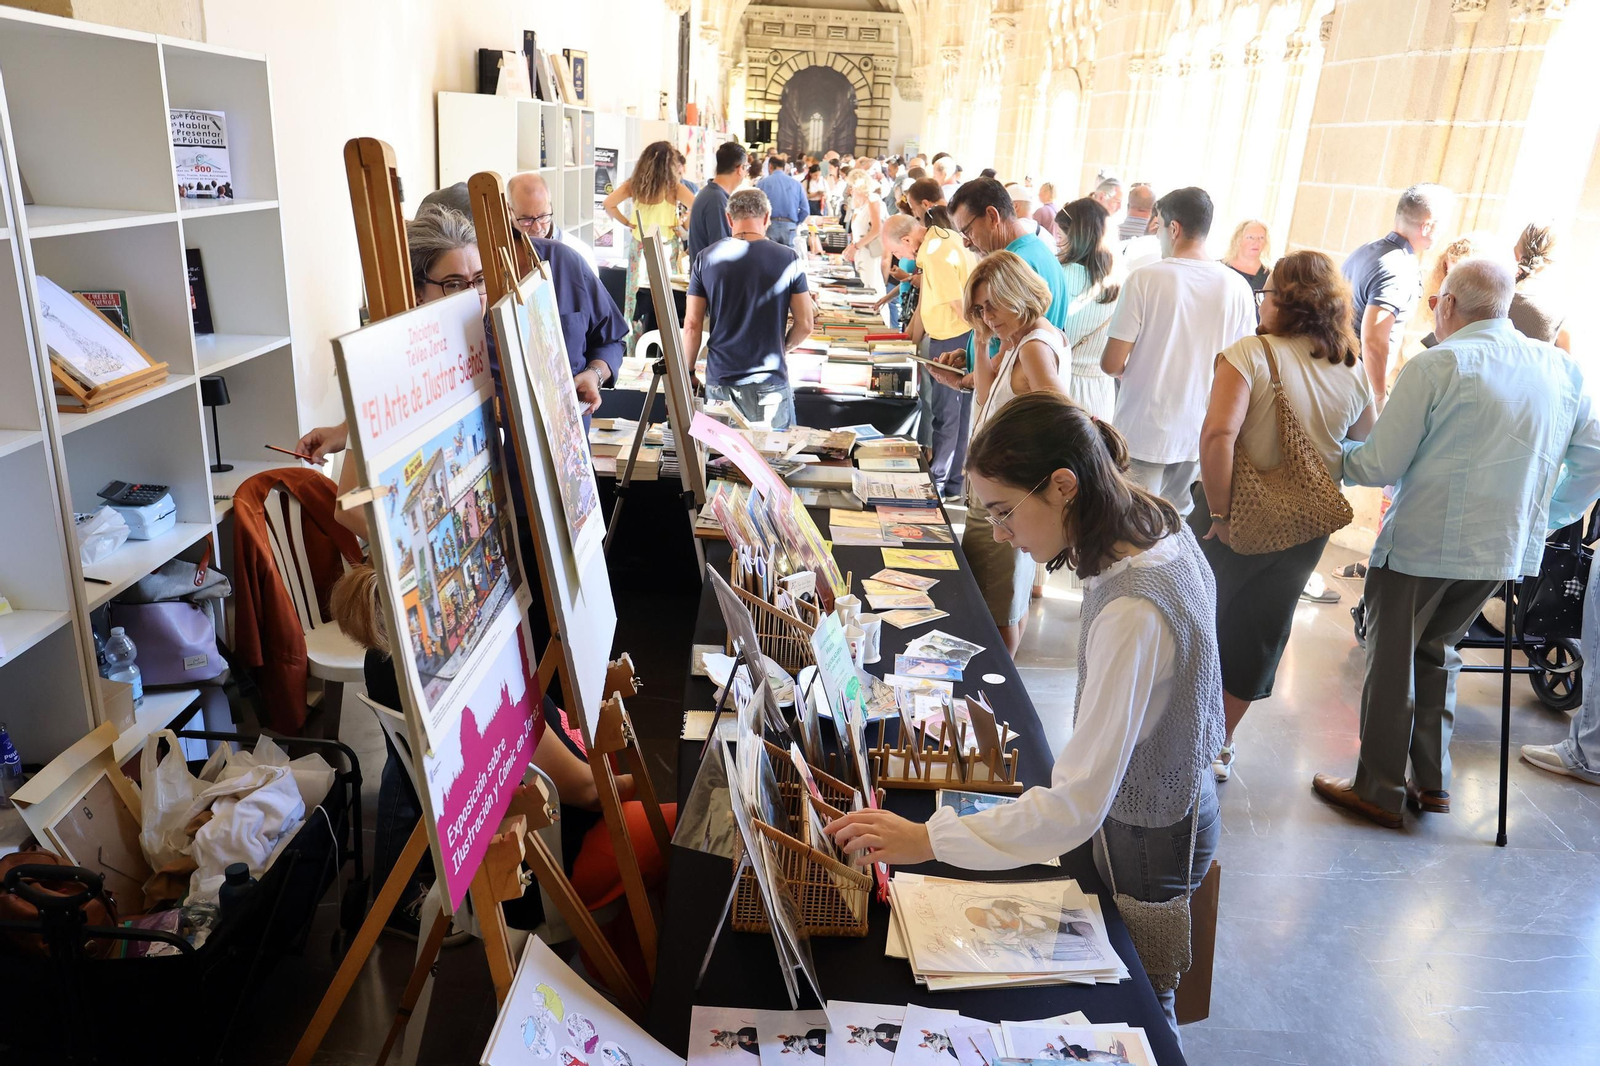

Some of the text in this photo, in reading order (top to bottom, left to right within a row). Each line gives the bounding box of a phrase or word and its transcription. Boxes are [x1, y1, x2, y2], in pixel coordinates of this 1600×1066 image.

[180, 122, 210, 130] Hablar
[185, 112, 208, 121] Fácil
[176, 129, 221, 138] Presentar
[182, 136, 223, 145] Público!!
[408, 322, 440, 346] Iniciativa
[406, 338, 448, 368] TeVeo Jerez
[362, 340, 484, 439] "El Arte de Ilustrar Sueños"
[446, 738, 507, 848] Exposición sobre
[452, 704, 540, 876] Ilustración y Cómic en Jerez
